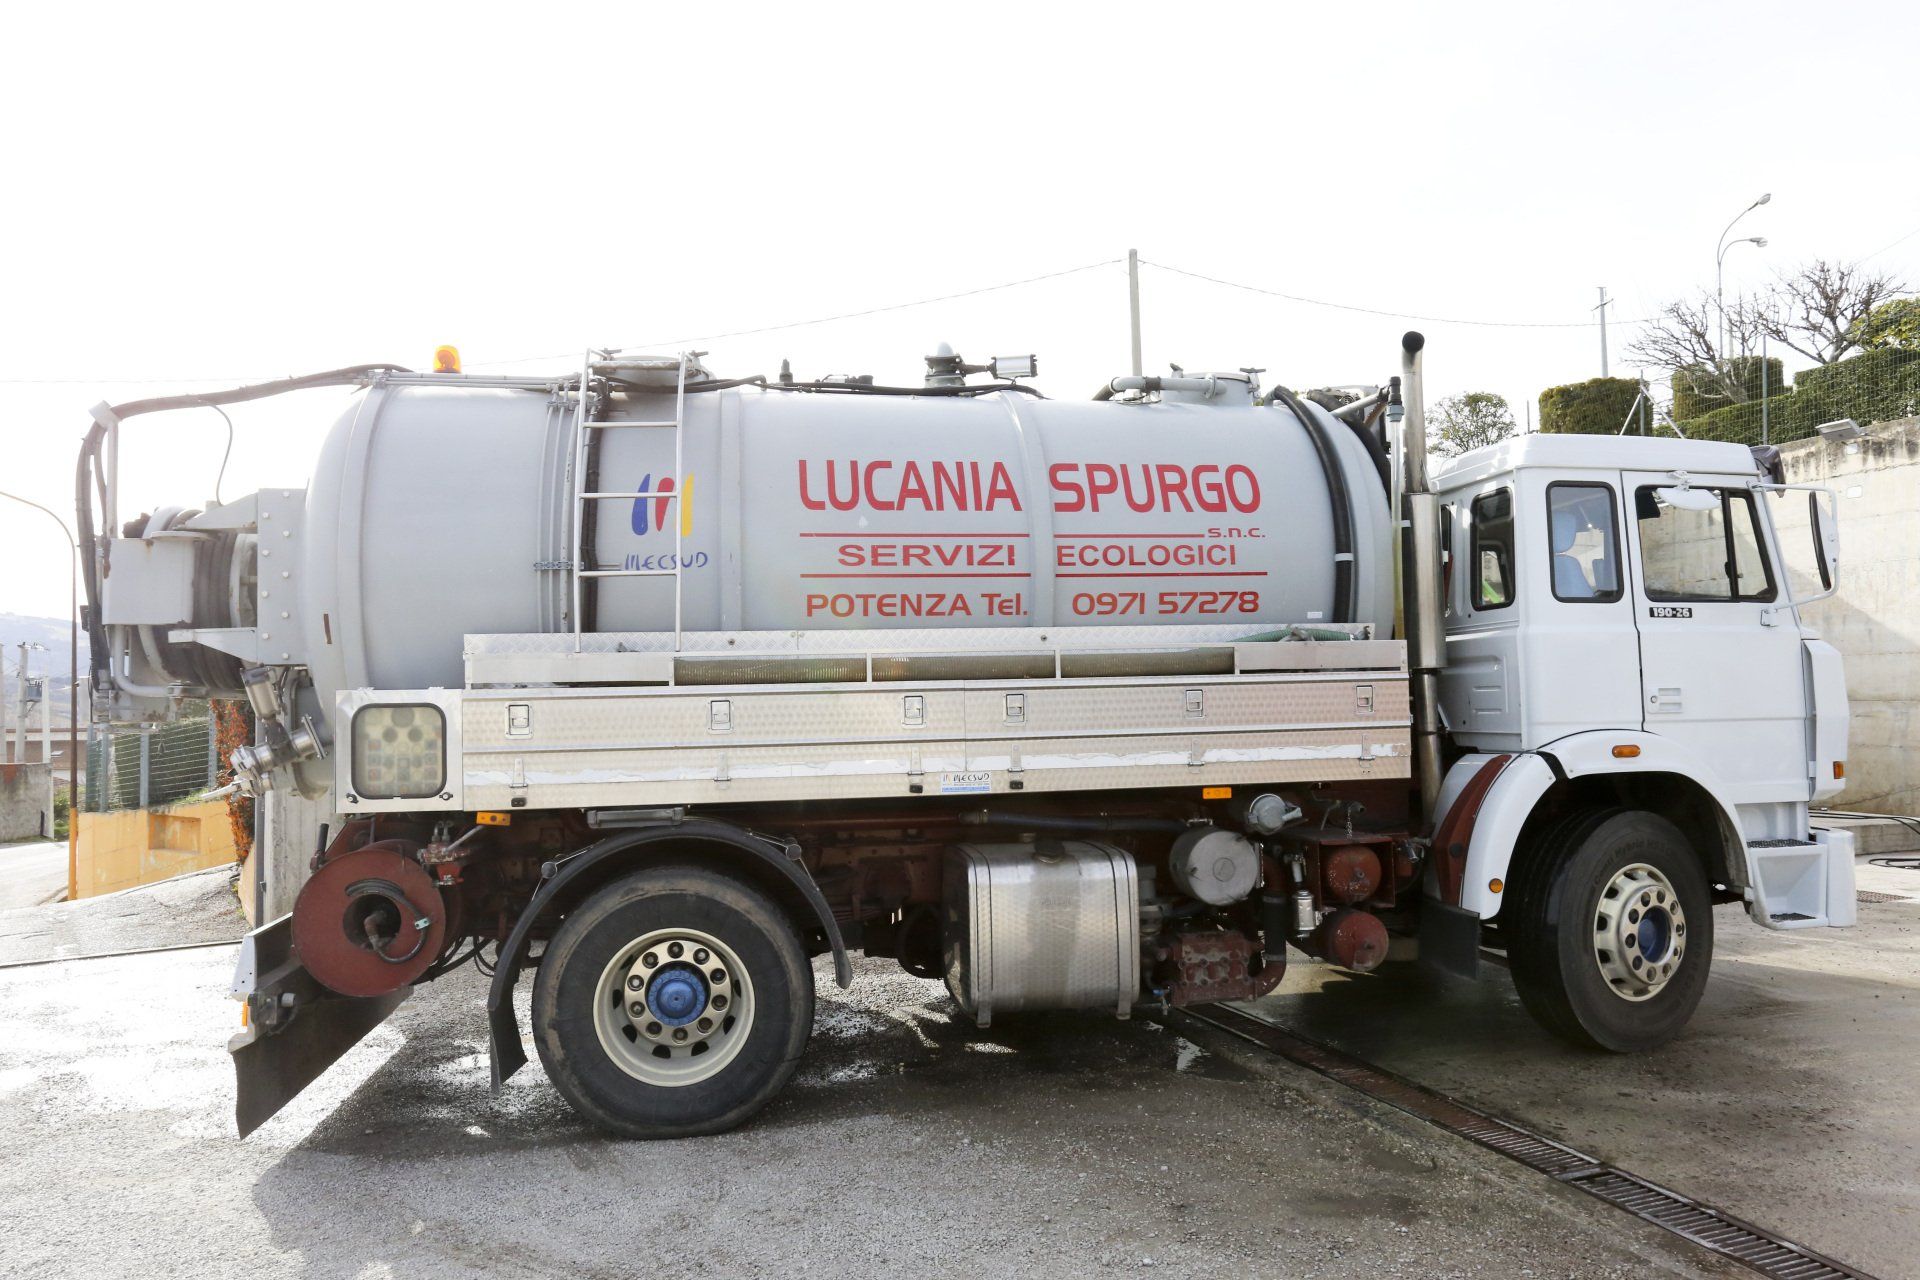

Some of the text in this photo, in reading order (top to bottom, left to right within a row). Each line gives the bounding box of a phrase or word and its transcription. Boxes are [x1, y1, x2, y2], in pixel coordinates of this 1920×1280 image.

[798, 459, 1262, 514] LUCANIA SPURGO
[1208, 527, 1266, 539] s.n.c.
[624, 551, 709, 571] MECSUD
[838, 543, 1236, 567] SERVIZI ECOLOGICI
[806, 591, 1261, 617] POTENZA Tel. 0971 57278
[1652, 607, 1690, 618] 190-26
